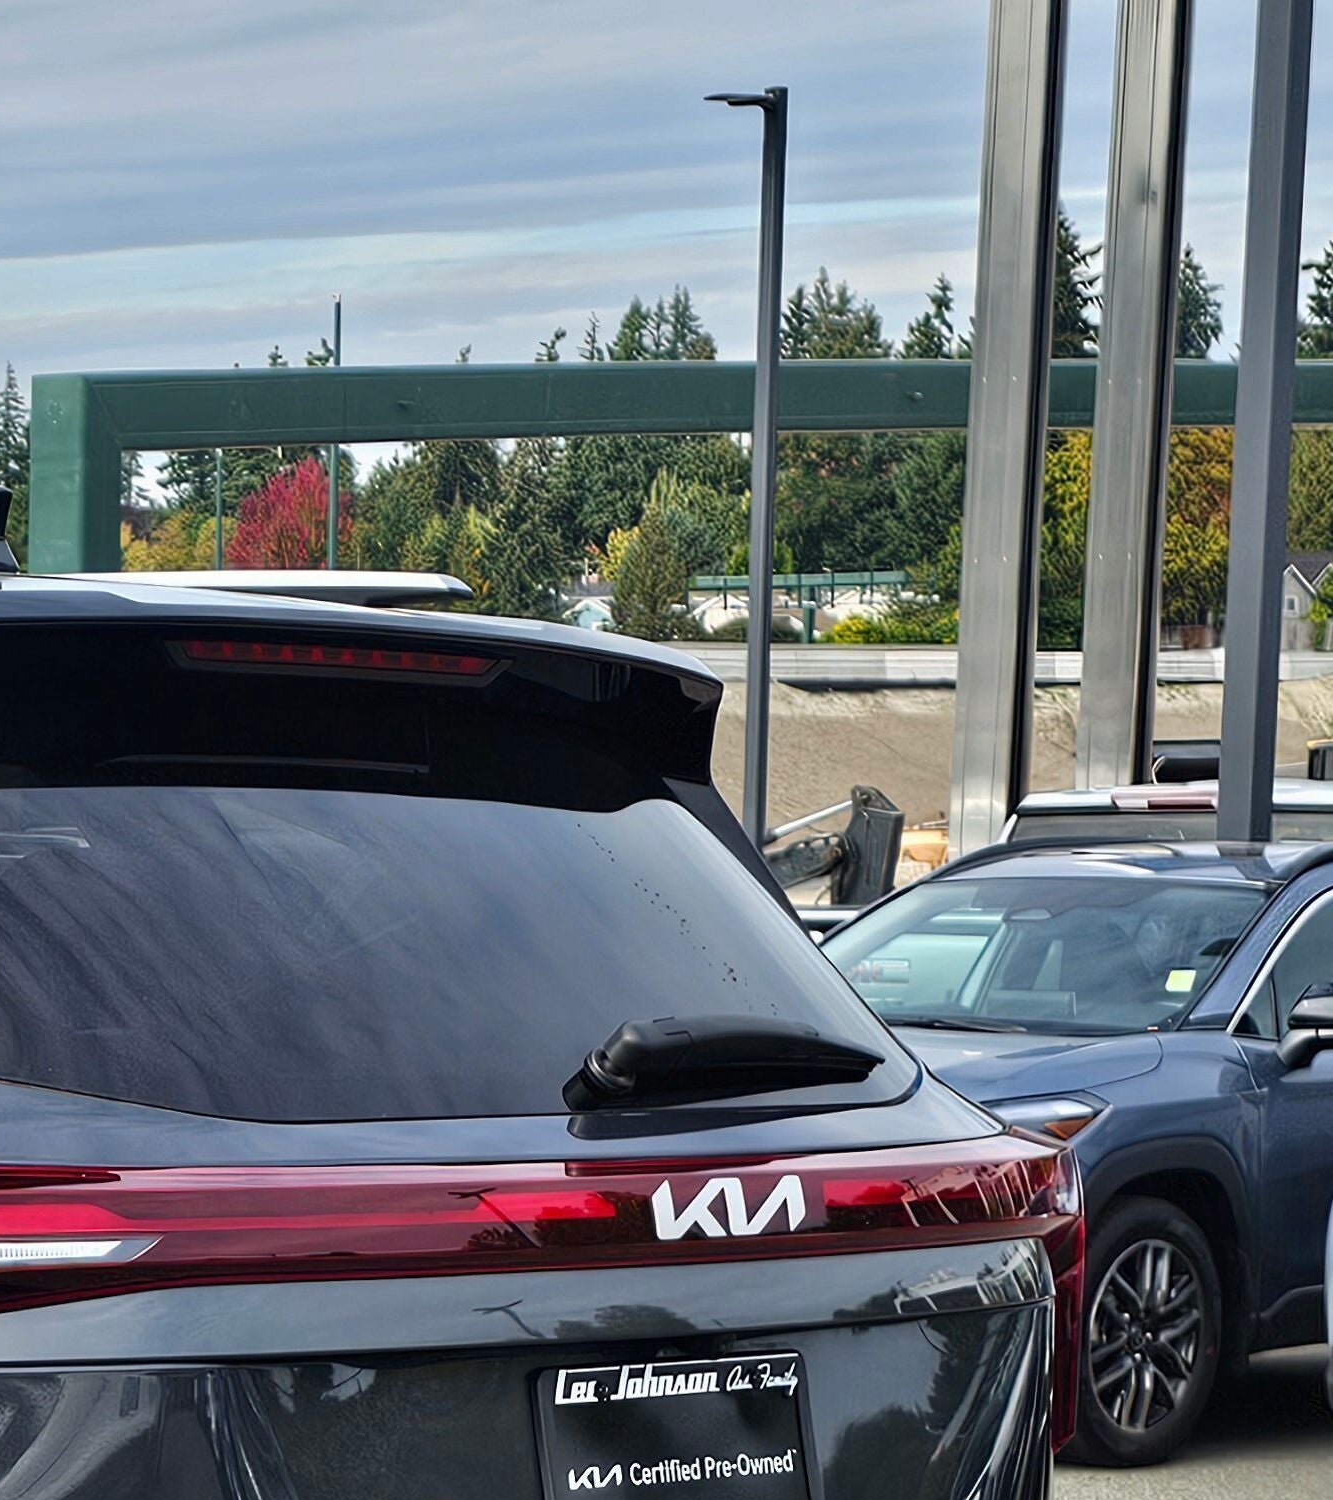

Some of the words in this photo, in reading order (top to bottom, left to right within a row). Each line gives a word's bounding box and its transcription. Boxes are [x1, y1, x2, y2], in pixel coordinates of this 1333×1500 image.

[651, 1174, 807, 1241] KIA
[610, 1363, 721, 1401] Johnson
[726, 1364, 753, 1392] Aut
[568, 1463, 623, 1491] KIA
[629, 1457, 702, 1486] Certified
[703, 1448, 796, 1480] Pre-Owned
